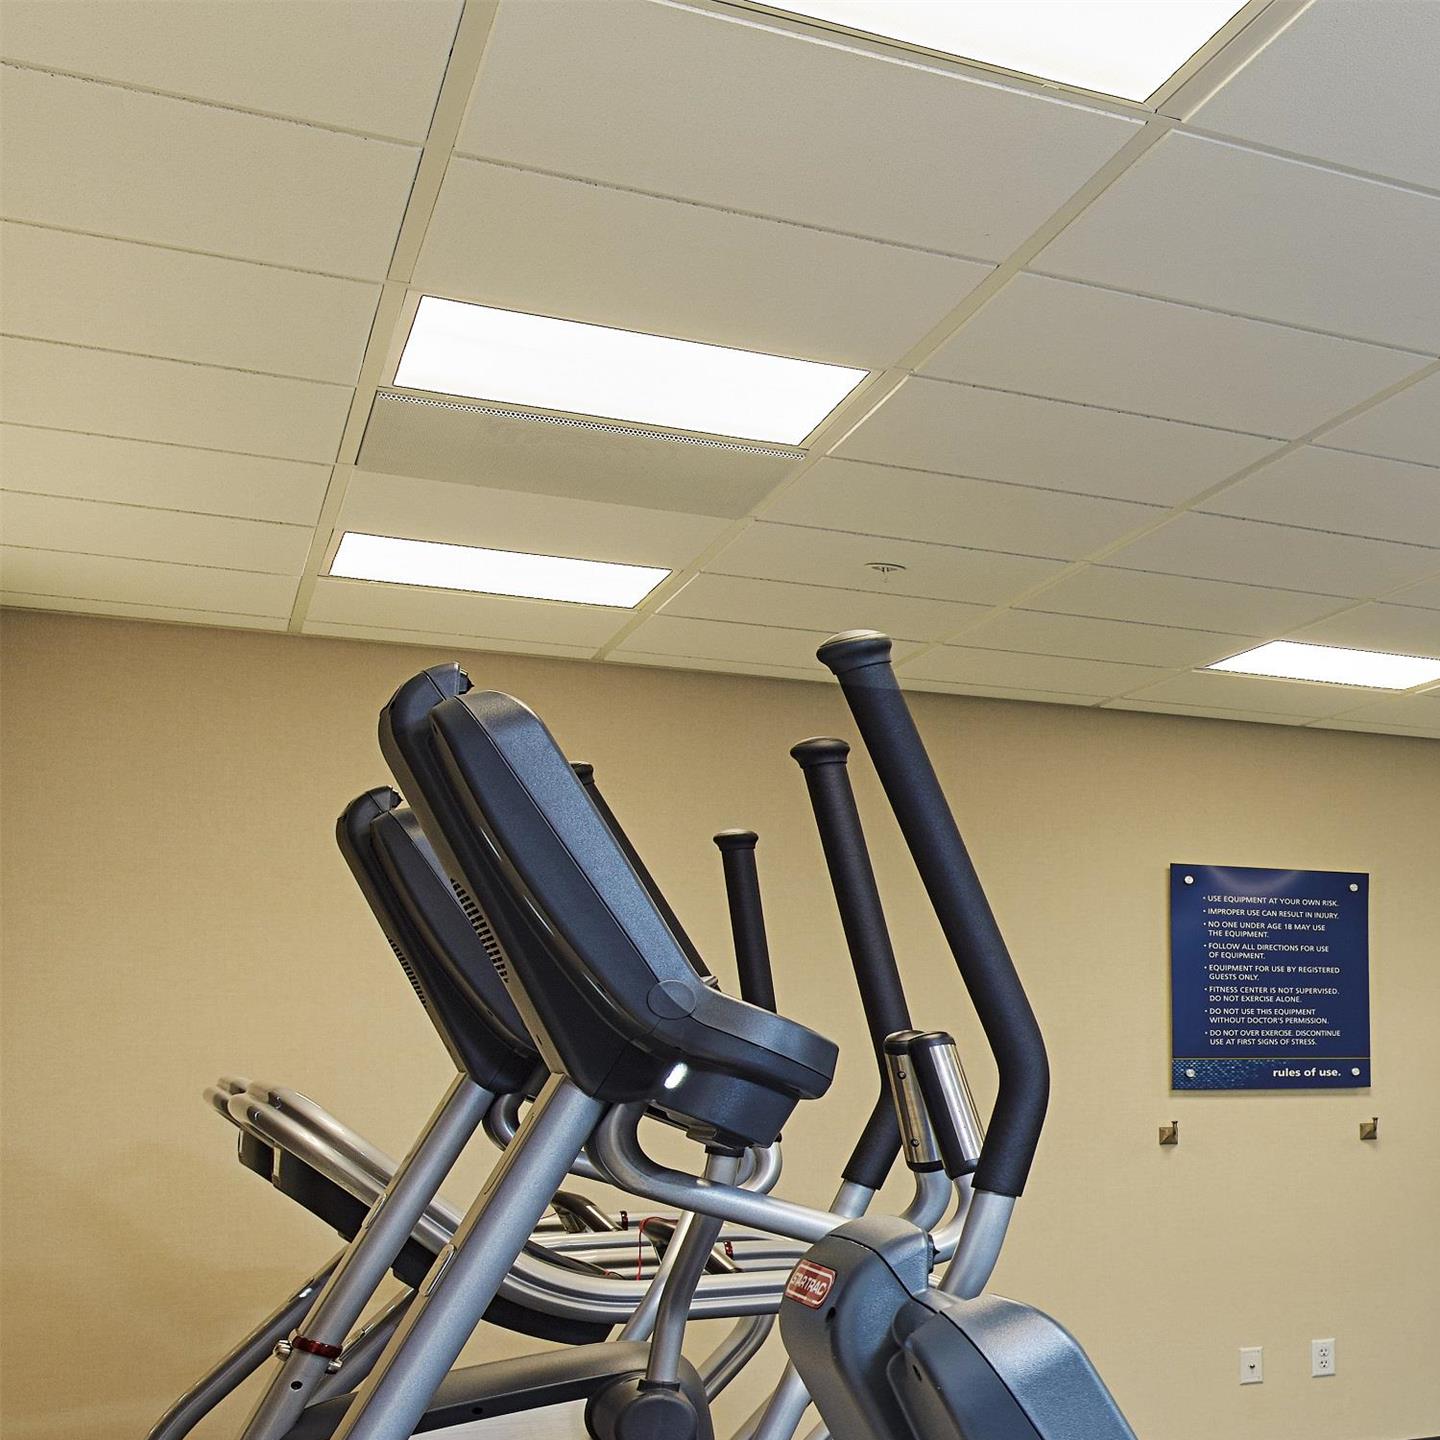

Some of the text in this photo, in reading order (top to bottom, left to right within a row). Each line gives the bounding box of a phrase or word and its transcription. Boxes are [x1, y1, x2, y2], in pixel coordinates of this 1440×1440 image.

[1224, 896, 1266, 904] EQUIPMENT
[1208, 908, 1245, 916] IMPROPER
[1273, 1068, 1301, 1076] rules
[1304, 1068, 1316, 1076] of
